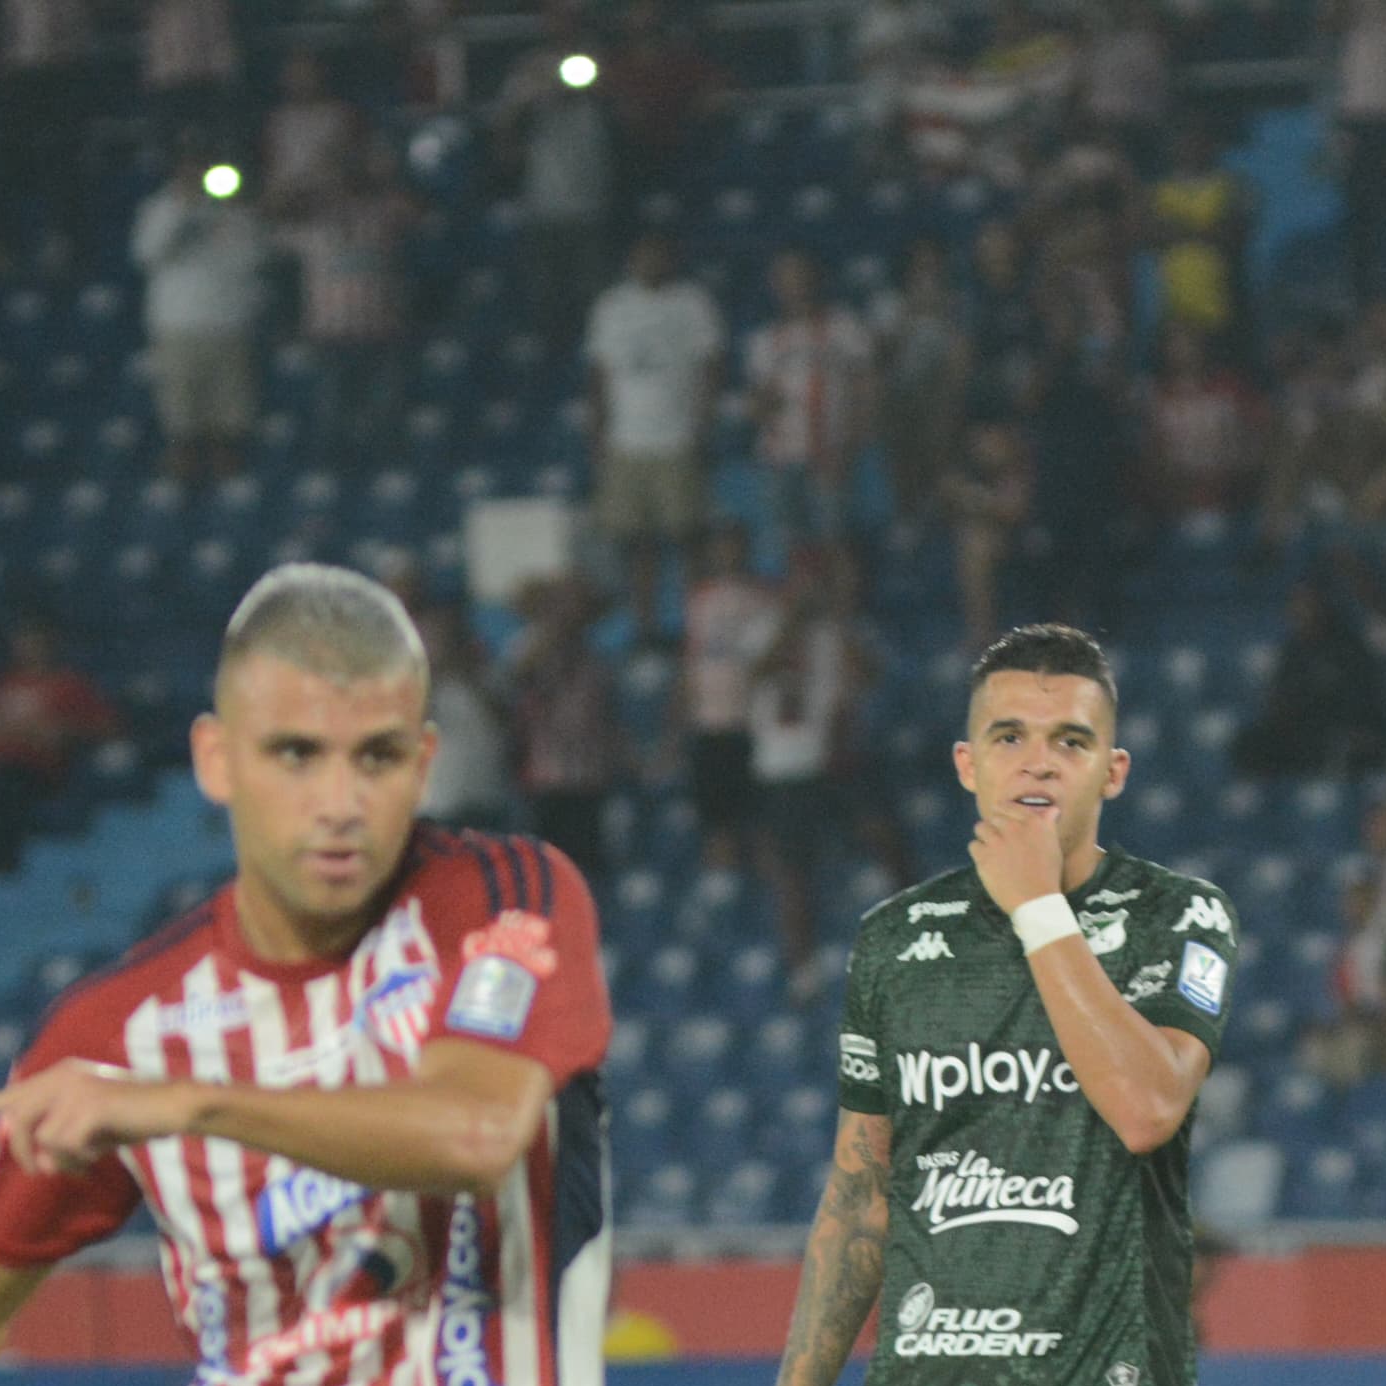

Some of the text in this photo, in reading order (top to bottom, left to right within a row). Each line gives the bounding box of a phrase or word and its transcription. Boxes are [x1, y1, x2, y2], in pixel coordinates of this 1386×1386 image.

[916, 1150, 990, 1176] PASTAS La
[912, 1168, 1075, 1224] Muñeca
[926, 1308, 1022, 1332] FLUO
[896, 1332, 1063, 1357] CARDENT
